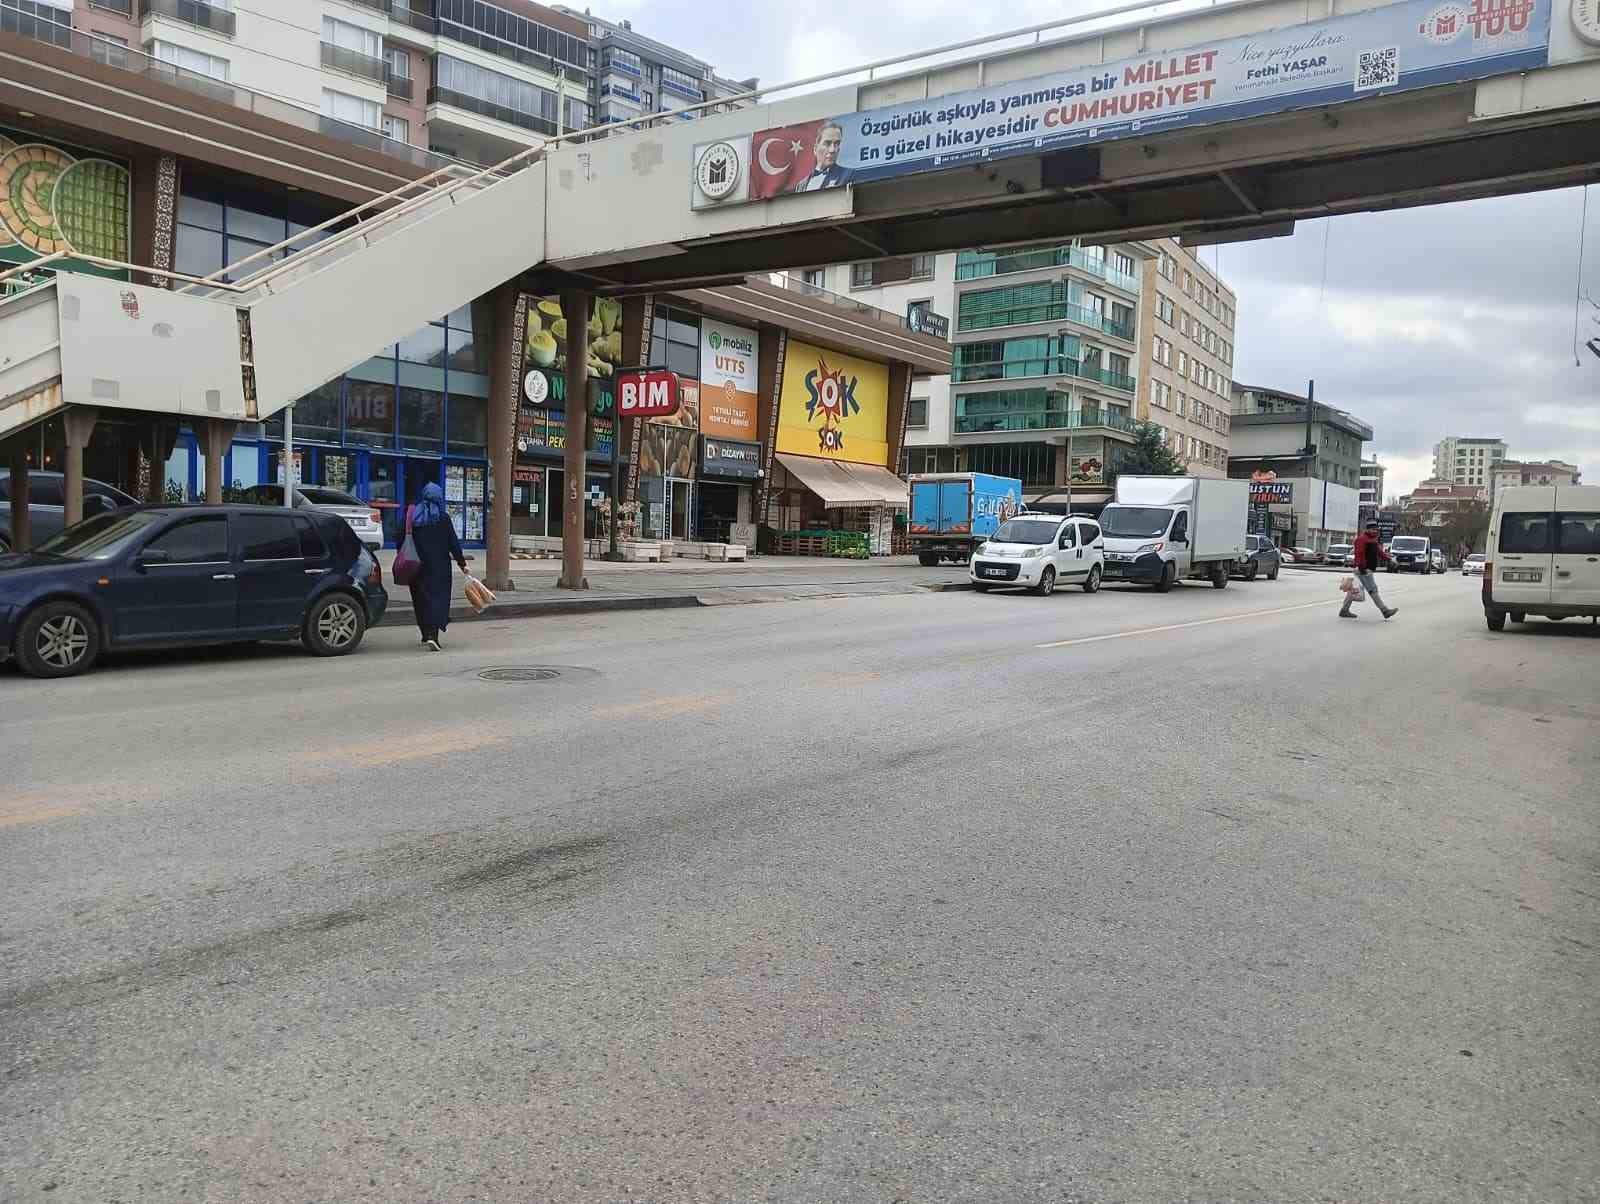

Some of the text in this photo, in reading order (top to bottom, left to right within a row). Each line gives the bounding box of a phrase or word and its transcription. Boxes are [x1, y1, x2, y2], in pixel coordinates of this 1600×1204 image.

[1246, 55, 1328, 80] Fethi YAŞAR
[861, 50, 1218, 137] Özgürlük aşkıyla yanmışsa bir MİLLET
[860, 146, 880, 161] En
[885, 132, 931, 160] güzel
[936, 116, 1038, 148] hikayesidir
[1043, 79, 1217, 128] CUMHURİYET
[715, 354, 745, 374] UTTS
[621, 375, 669, 411] BİM
